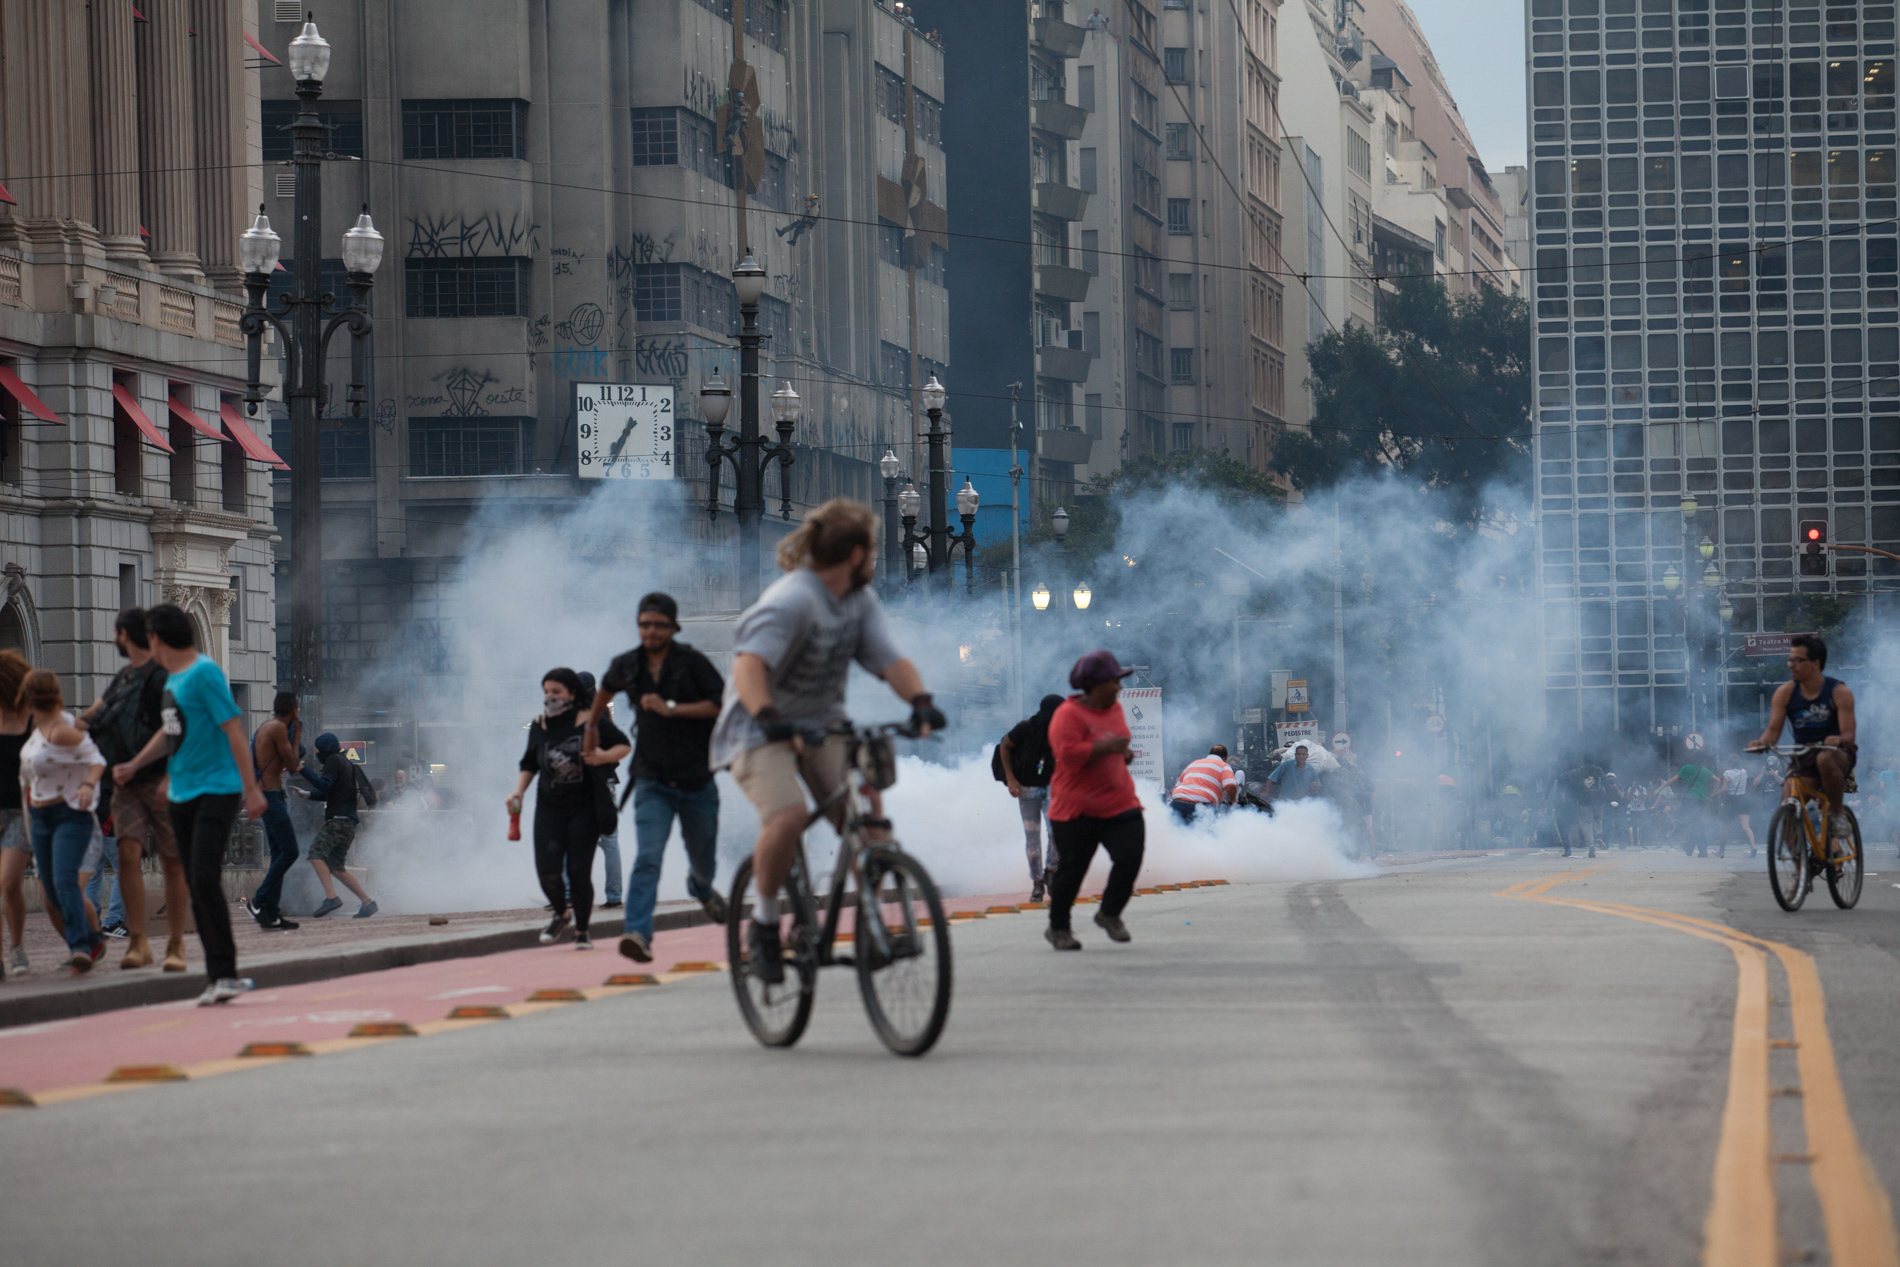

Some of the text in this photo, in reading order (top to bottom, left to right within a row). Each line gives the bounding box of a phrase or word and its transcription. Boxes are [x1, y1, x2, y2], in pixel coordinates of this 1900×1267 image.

[600, 386, 647, 401] 11 12 1
[578, 396, 593, 412] 10
[660, 398, 671, 413] 2
[580, 424, 591, 439] 9
[660, 426, 671, 441] 3
[581, 450, 592, 465] 8
[660, 451, 671, 466] 4
[603, 463, 650, 478] 7 6 5
